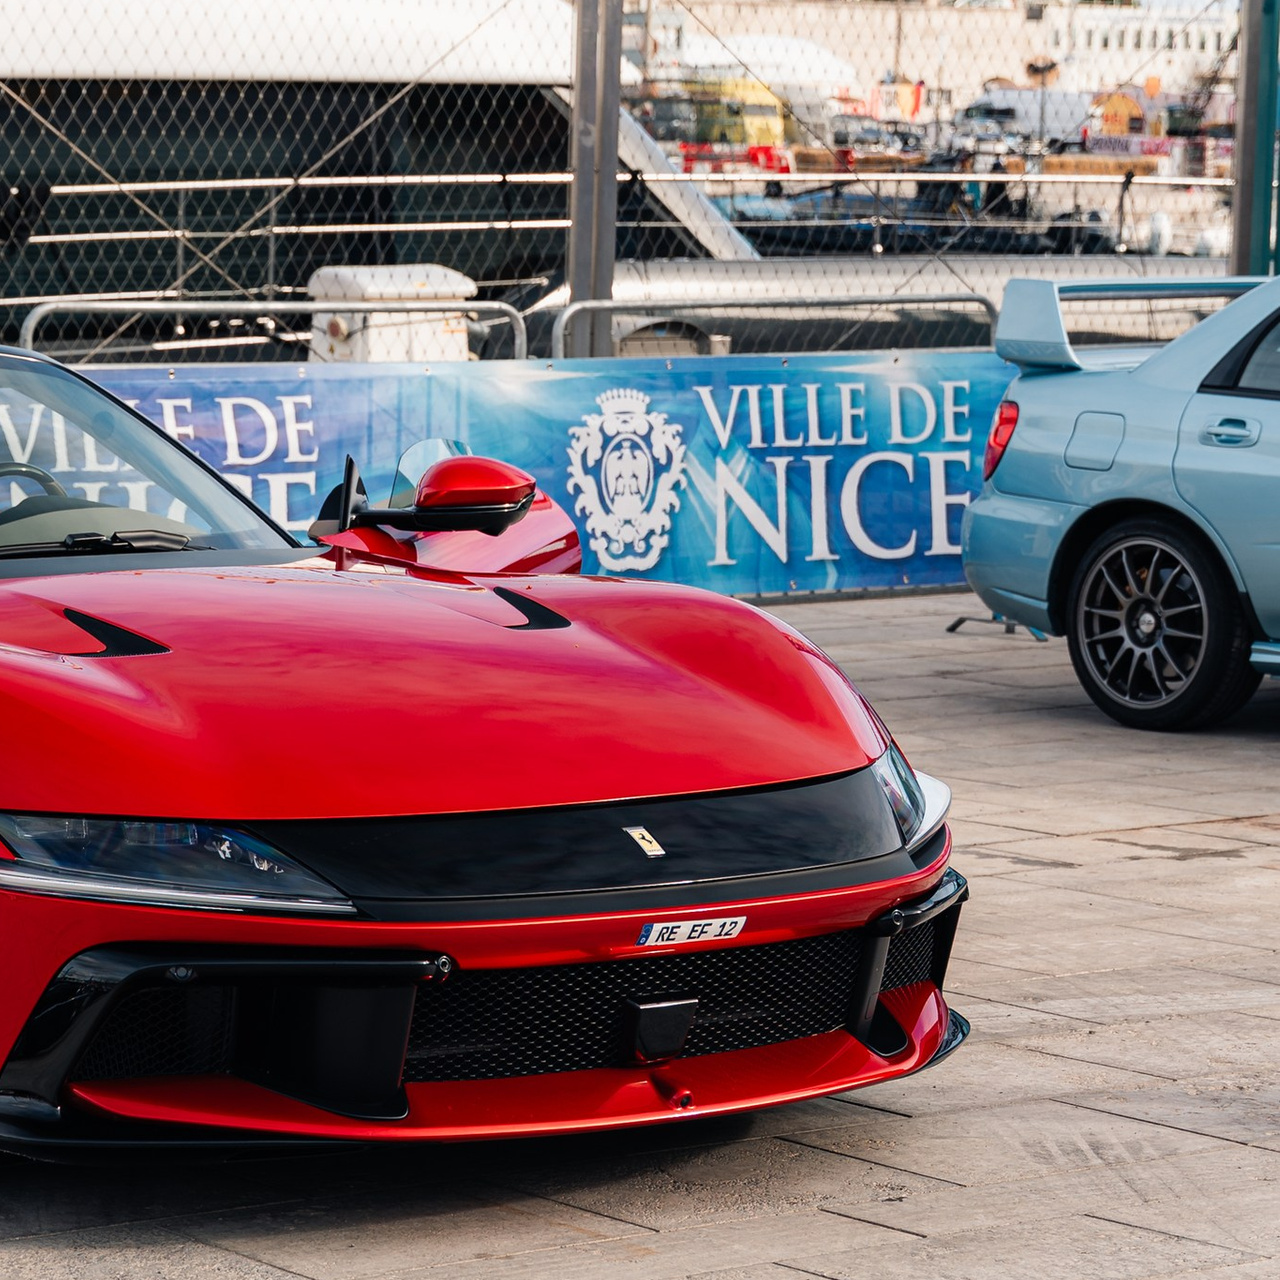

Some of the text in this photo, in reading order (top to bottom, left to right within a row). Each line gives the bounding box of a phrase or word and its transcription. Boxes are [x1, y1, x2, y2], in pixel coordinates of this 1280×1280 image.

[214, 394, 319, 467] DE
[692, 380, 973, 450] VILLE DE
[706, 449, 971, 567] NICE
[655, 921, 738, 942] RE EF 12
